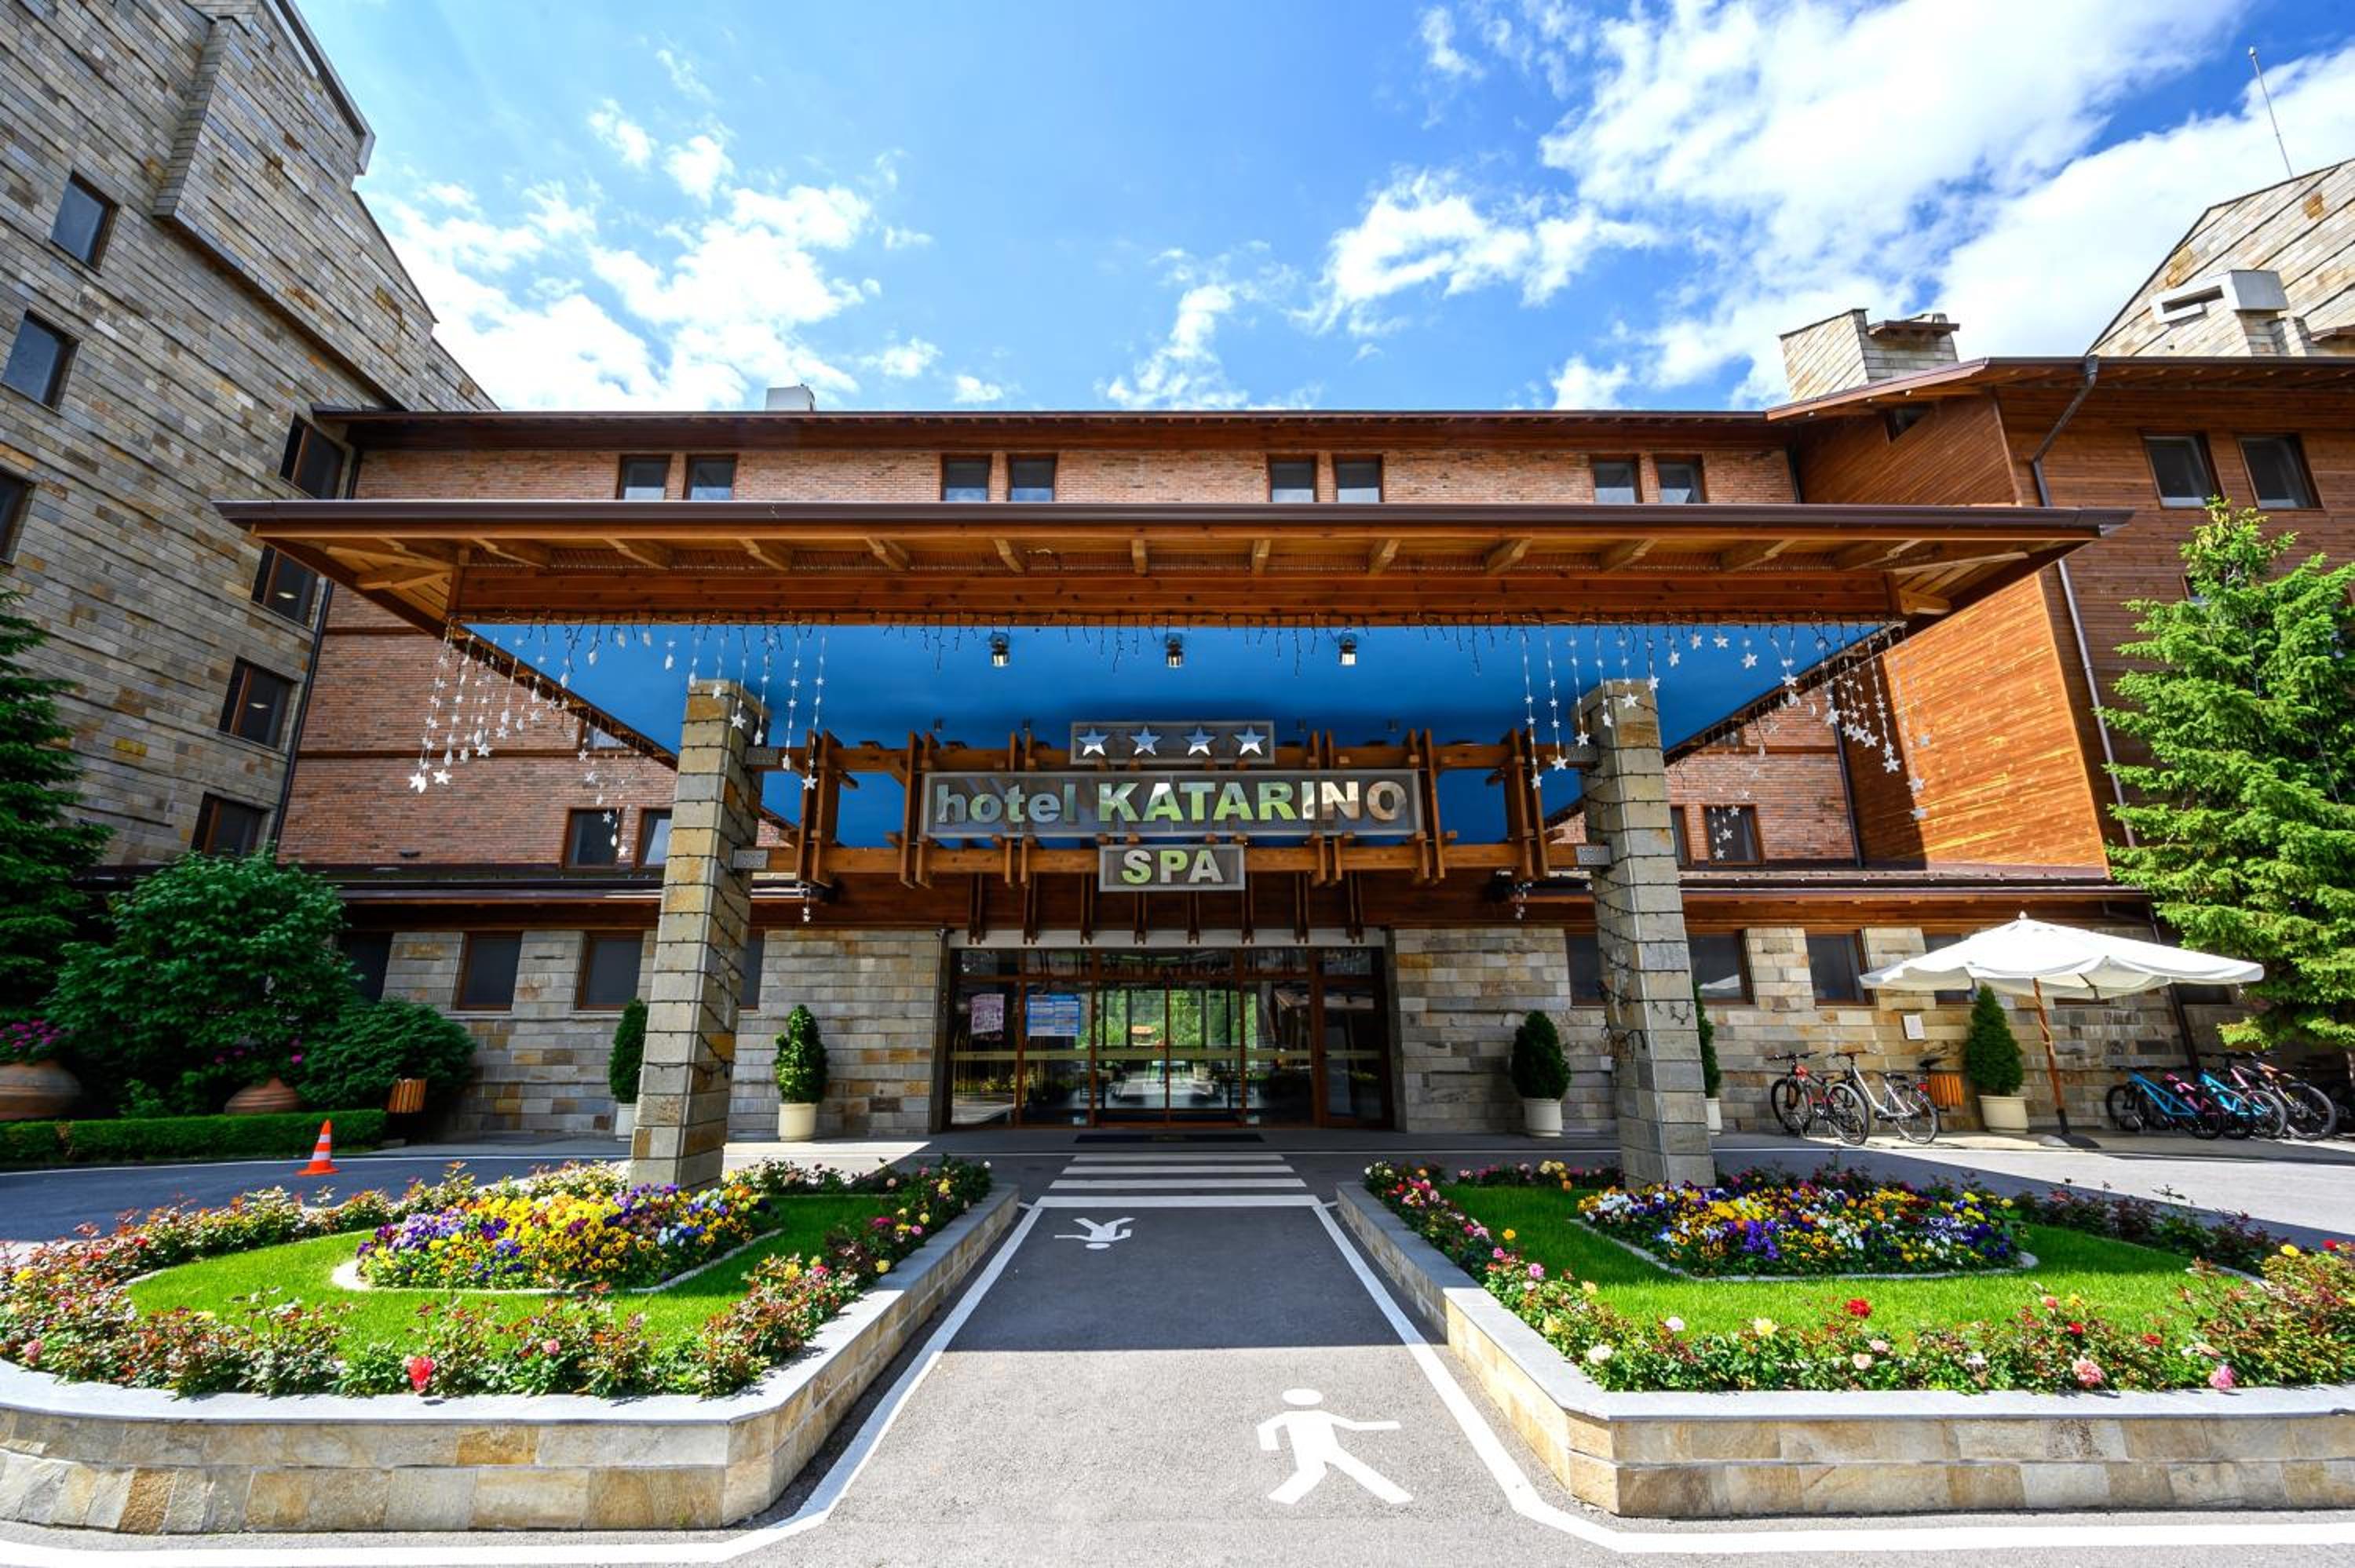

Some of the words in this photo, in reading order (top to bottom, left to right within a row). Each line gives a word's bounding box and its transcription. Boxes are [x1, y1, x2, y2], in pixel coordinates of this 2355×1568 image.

[937, 783, 1076, 823] hotel
[1098, 781, 1407, 822] KATARINO
[1122, 849, 1224, 884] SPA
